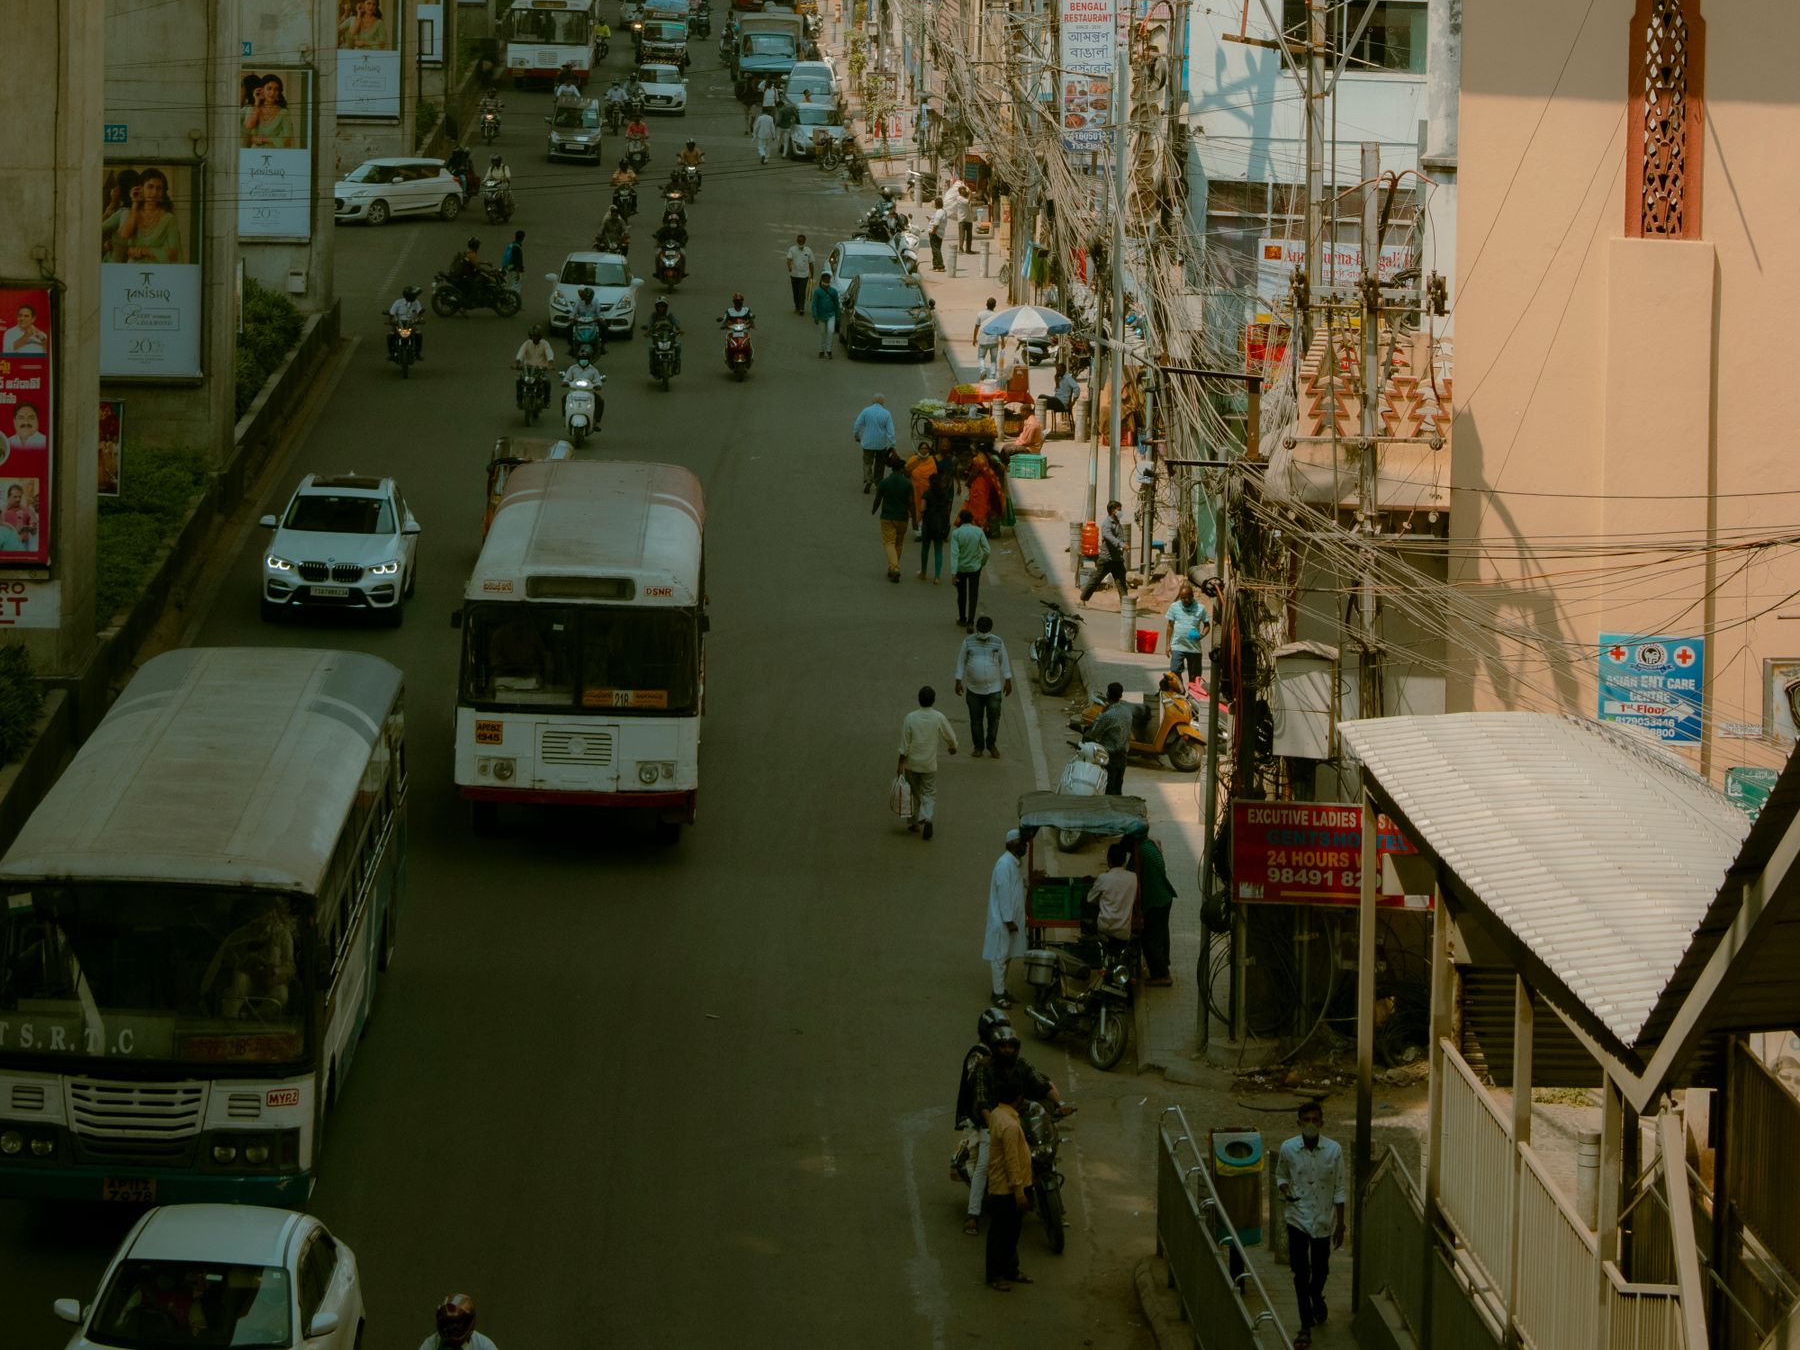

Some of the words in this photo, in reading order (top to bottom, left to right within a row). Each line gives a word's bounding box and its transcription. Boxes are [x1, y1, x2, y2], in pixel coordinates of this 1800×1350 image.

[1069, 2, 1107, 11] BENGALI
[1064, 13, 1112, 23] RESTAURANT
[1067, 31, 1110, 43] আমন্ত্রণ
[106, 126, 126, 141] 125
[248, 165, 286, 179] TANISHQ
[124, 285, 171, 303] TANISHQ
[645, 587, 673, 596] DSNR
[1605, 674, 1638, 688] ASIAN
[1641, 674, 1665, 688] ENT
[1667, 677, 1696, 690] CARE
[1629, 690, 1671, 703] CENTRE
[1636, 704, 1667, 715] Floor
[1247, 808, 1309, 826] EXCUTIVE
[1312, 810, 1357, 828] LADIES
[1266, 829, 1332, 847] GENTS
[1333, 831, 1409, 851] HOTEL
[1267, 850, 1287, 866] 24
[1291, 851, 1350, 868] HOURS
[1266, 867, 1335, 886] 98491
